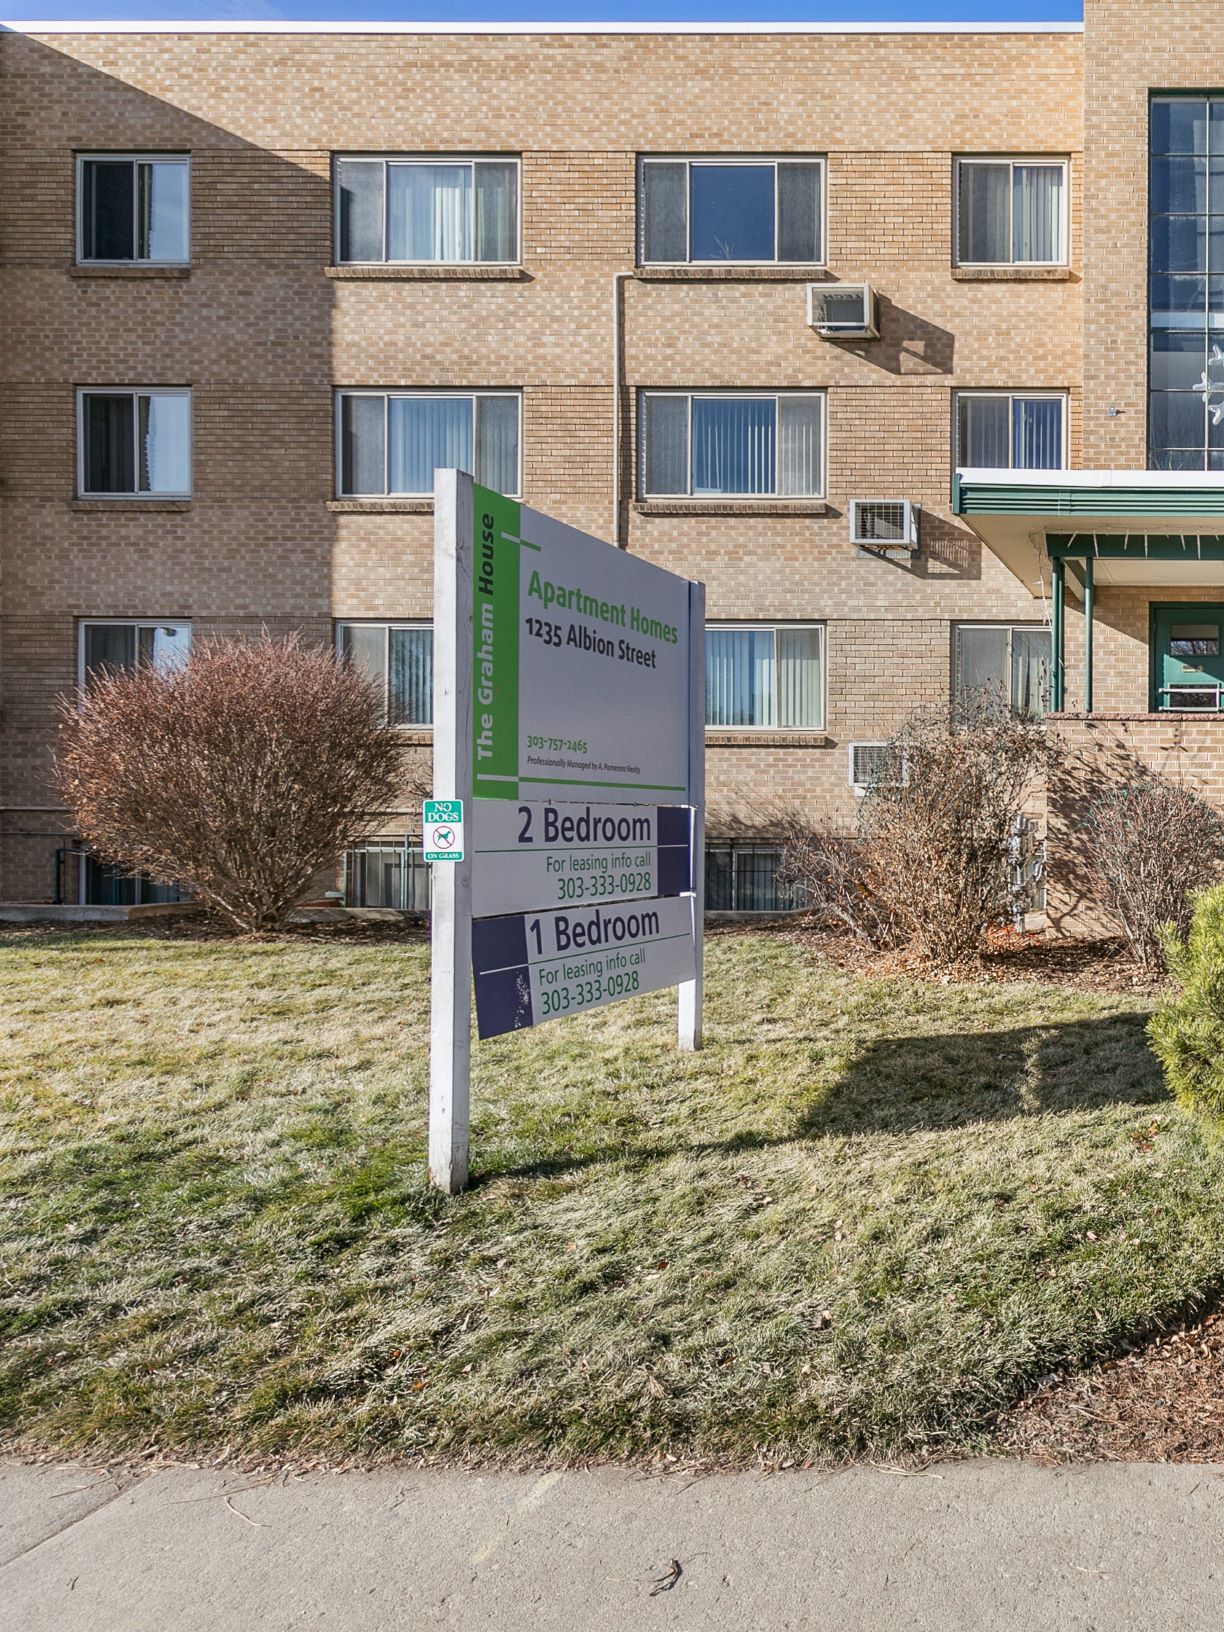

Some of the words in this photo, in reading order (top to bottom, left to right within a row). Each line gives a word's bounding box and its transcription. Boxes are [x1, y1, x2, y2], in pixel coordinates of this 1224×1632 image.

[479, 513, 494, 595] House
[527, 570, 626, 627] Apartment
[630, 607, 678, 644] Homes
[477, 603, 494, 705] Graham
[525, 617, 562, 648] 1235
[566, 624, 614, 657] Albion
[618, 640, 656, 669] Street
[477, 713, 494, 760] The
[527, 735, 588, 754] 303-757-2465
[527, 756, 566, 769] Professionally
[567, 760, 591, 771] Managed
[592, 762, 598, 772] by
[428, 812, 459, 822] DOGS
[434, 802, 452, 812] NO
[517, 806, 533, 843] 2
[544, 806, 651, 843] Bedroom
[547, 856, 566, 873] For
[569, 854, 608, 874] leasing
[611, 853, 632, 869] info
[634, 851, 651, 867] call
[557, 872, 651, 901] 303-333-0928
[529, 918, 543, 955] 1
[554, 909, 660, 952] Bedroom
[539, 968, 559, 986] For
[562, 958, 603, 981] leasing
[606, 953, 626, 973] info
[629, 949, 646, 969] call
[541, 971, 640, 1015] 303-333-0928
